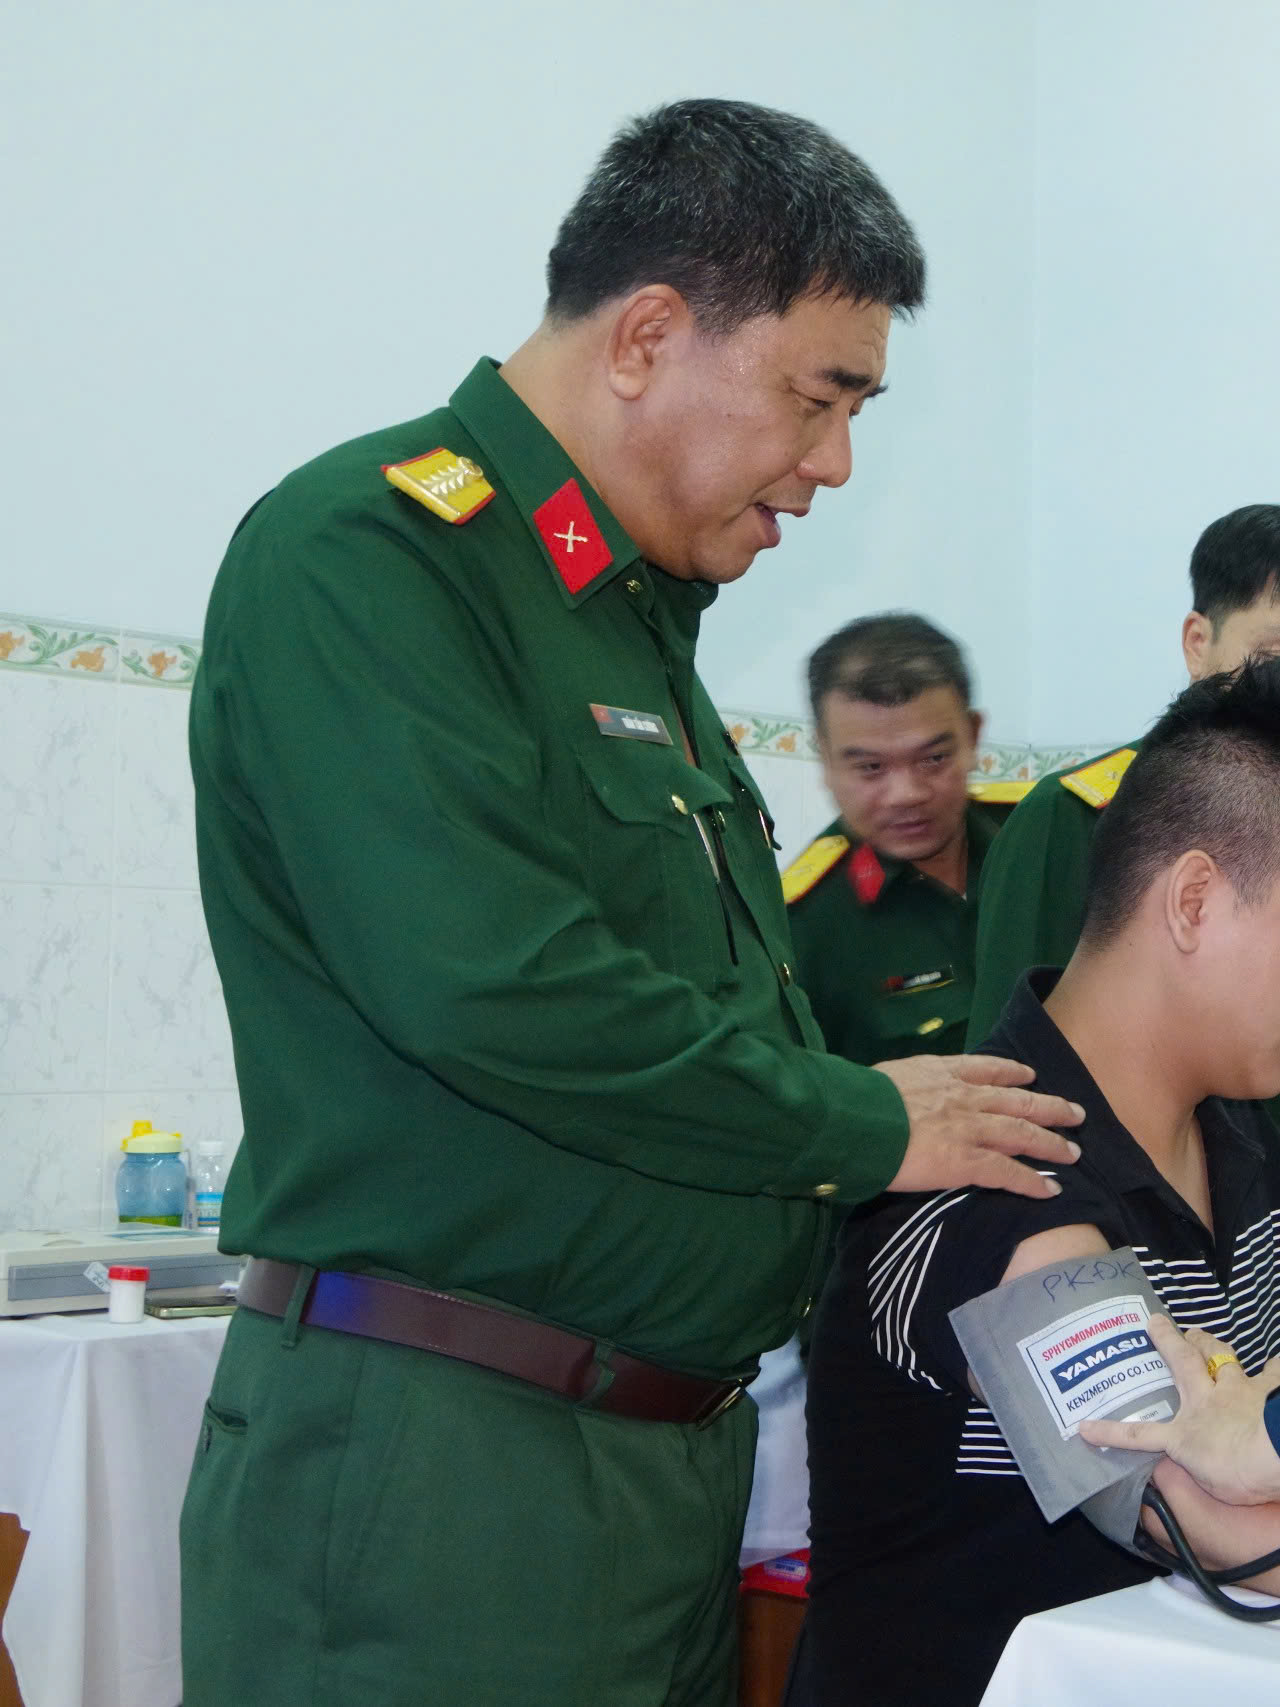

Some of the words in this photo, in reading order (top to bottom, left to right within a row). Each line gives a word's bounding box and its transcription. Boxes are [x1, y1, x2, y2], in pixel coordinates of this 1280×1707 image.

[1042, 1313, 1141, 1361] SPHYGMOMANOMETER
[1058, 1336, 1148, 1381] YAMASU
[1066, 1372, 1126, 1411] KENZMEDICO
[1127, 1366, 1145, 1378] CO.
